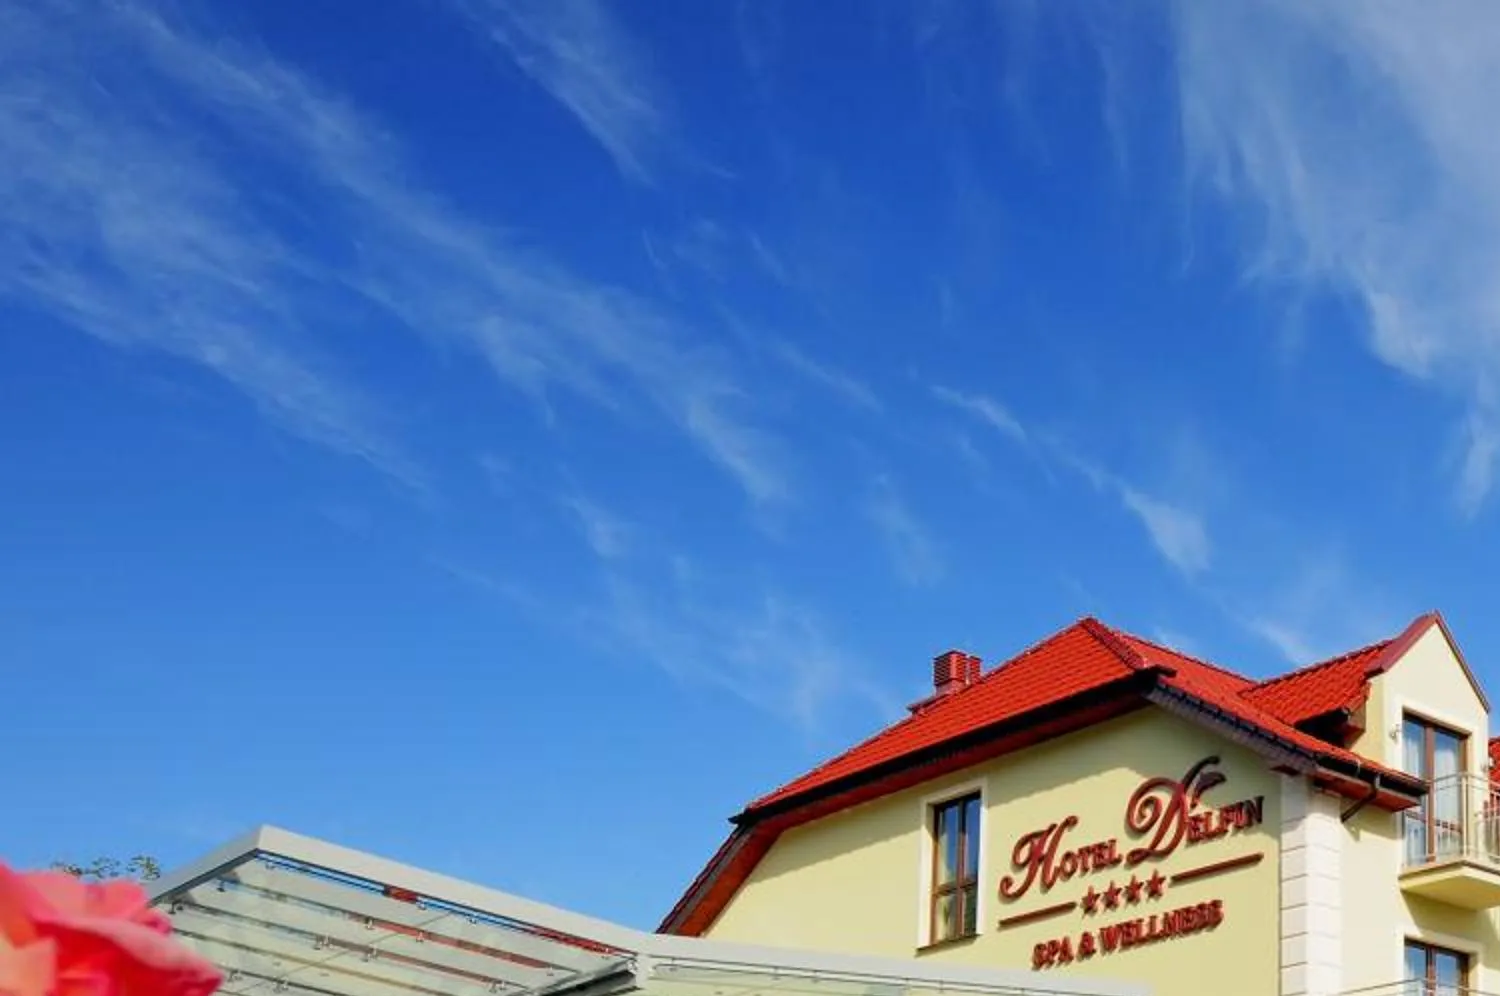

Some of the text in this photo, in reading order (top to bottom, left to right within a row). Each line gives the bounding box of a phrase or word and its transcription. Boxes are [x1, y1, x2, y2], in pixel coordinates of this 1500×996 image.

[1032, 899, 1224, 970] SPA & WELLNESS
